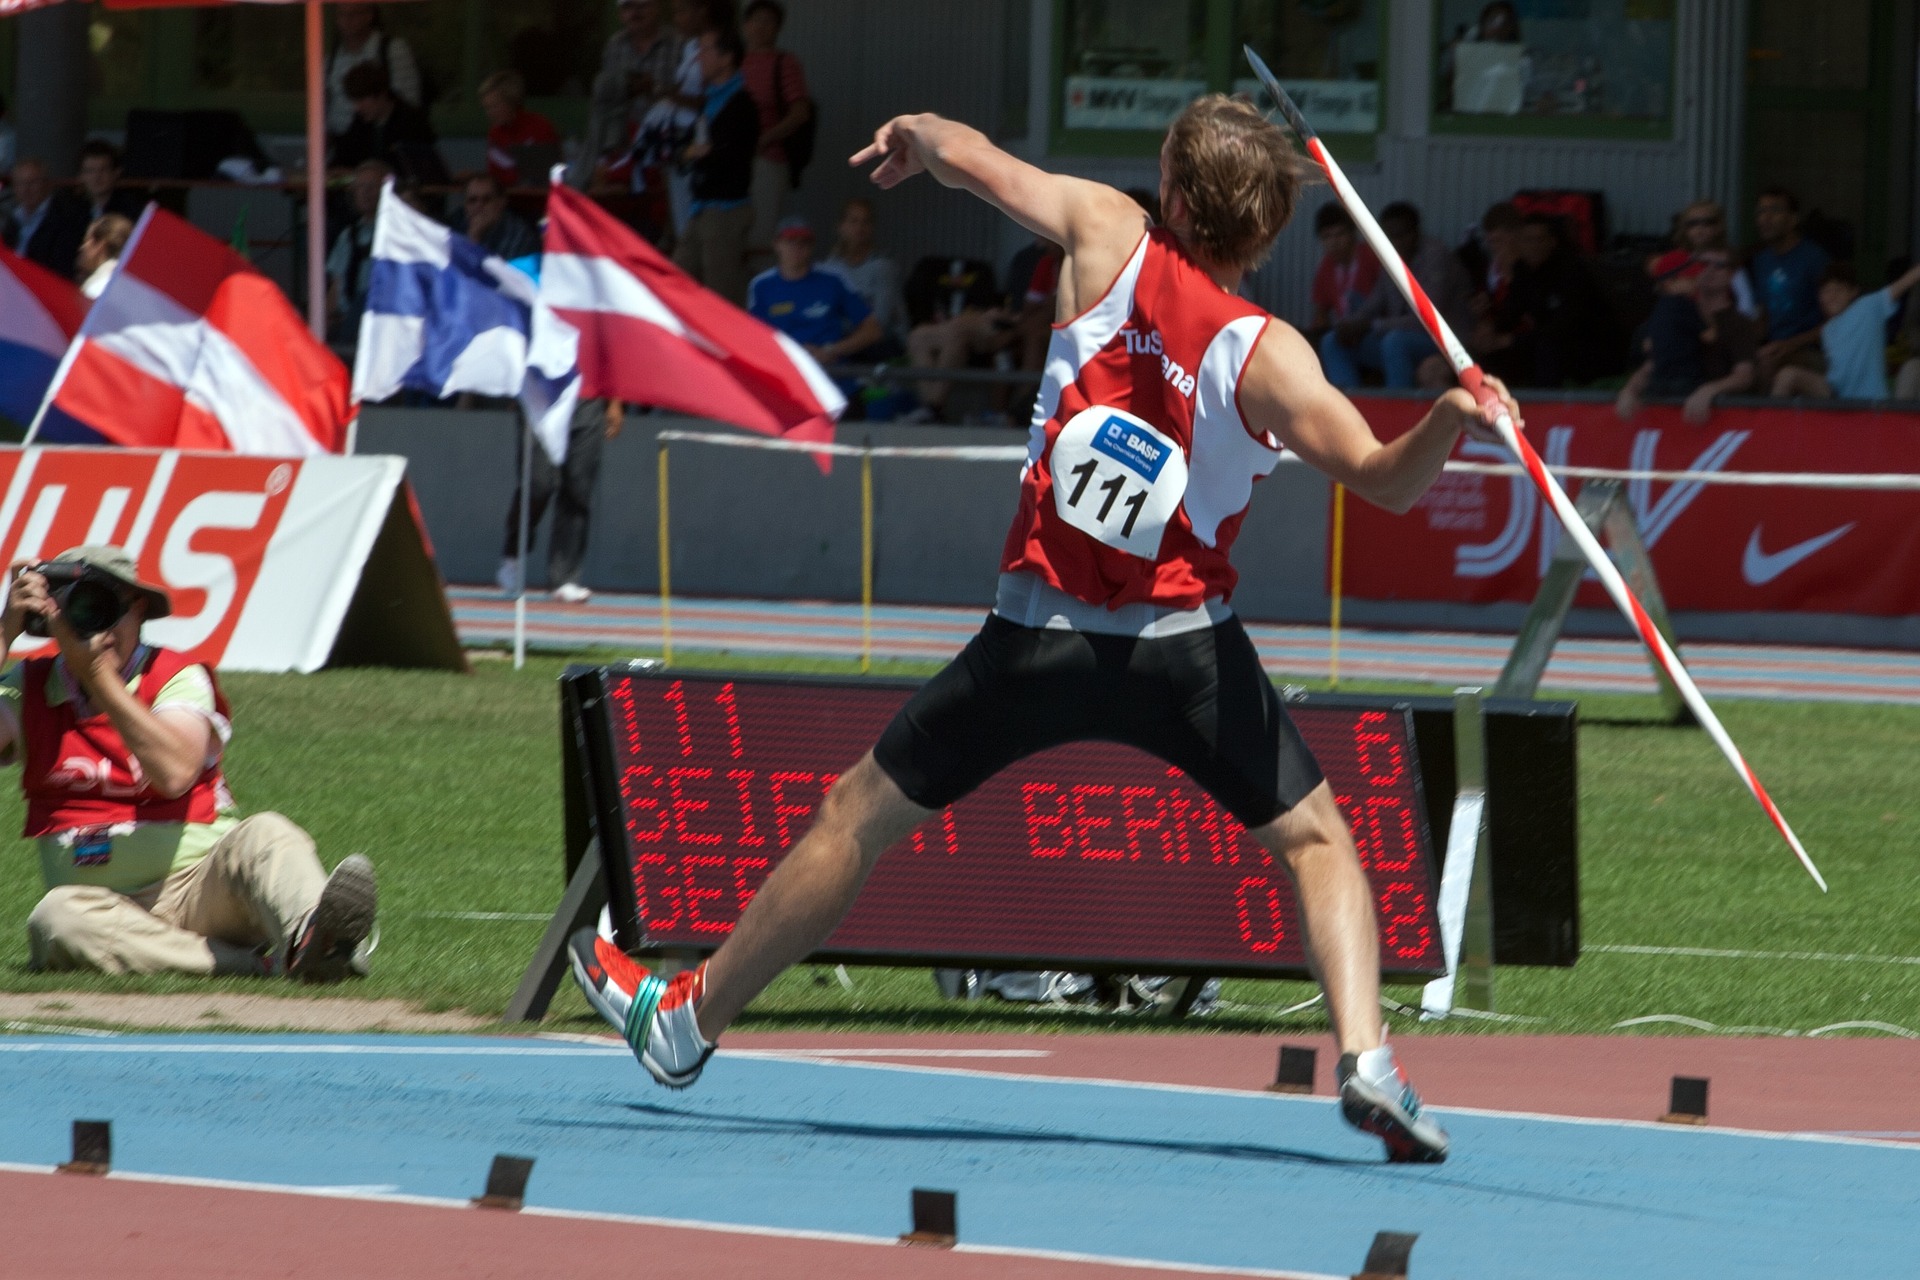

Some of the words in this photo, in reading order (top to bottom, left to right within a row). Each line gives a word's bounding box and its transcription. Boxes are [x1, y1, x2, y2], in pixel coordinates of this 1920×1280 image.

[1119, 329, 1163, 355] TuS
[1161, 353, 1195, 398] ena
[1127, 433, 1161, 461] BASF
[1067, 458, 1149, 540] 111
[612, 677, 743, 759] 111
[1354, 711, 1402, 786] 6
